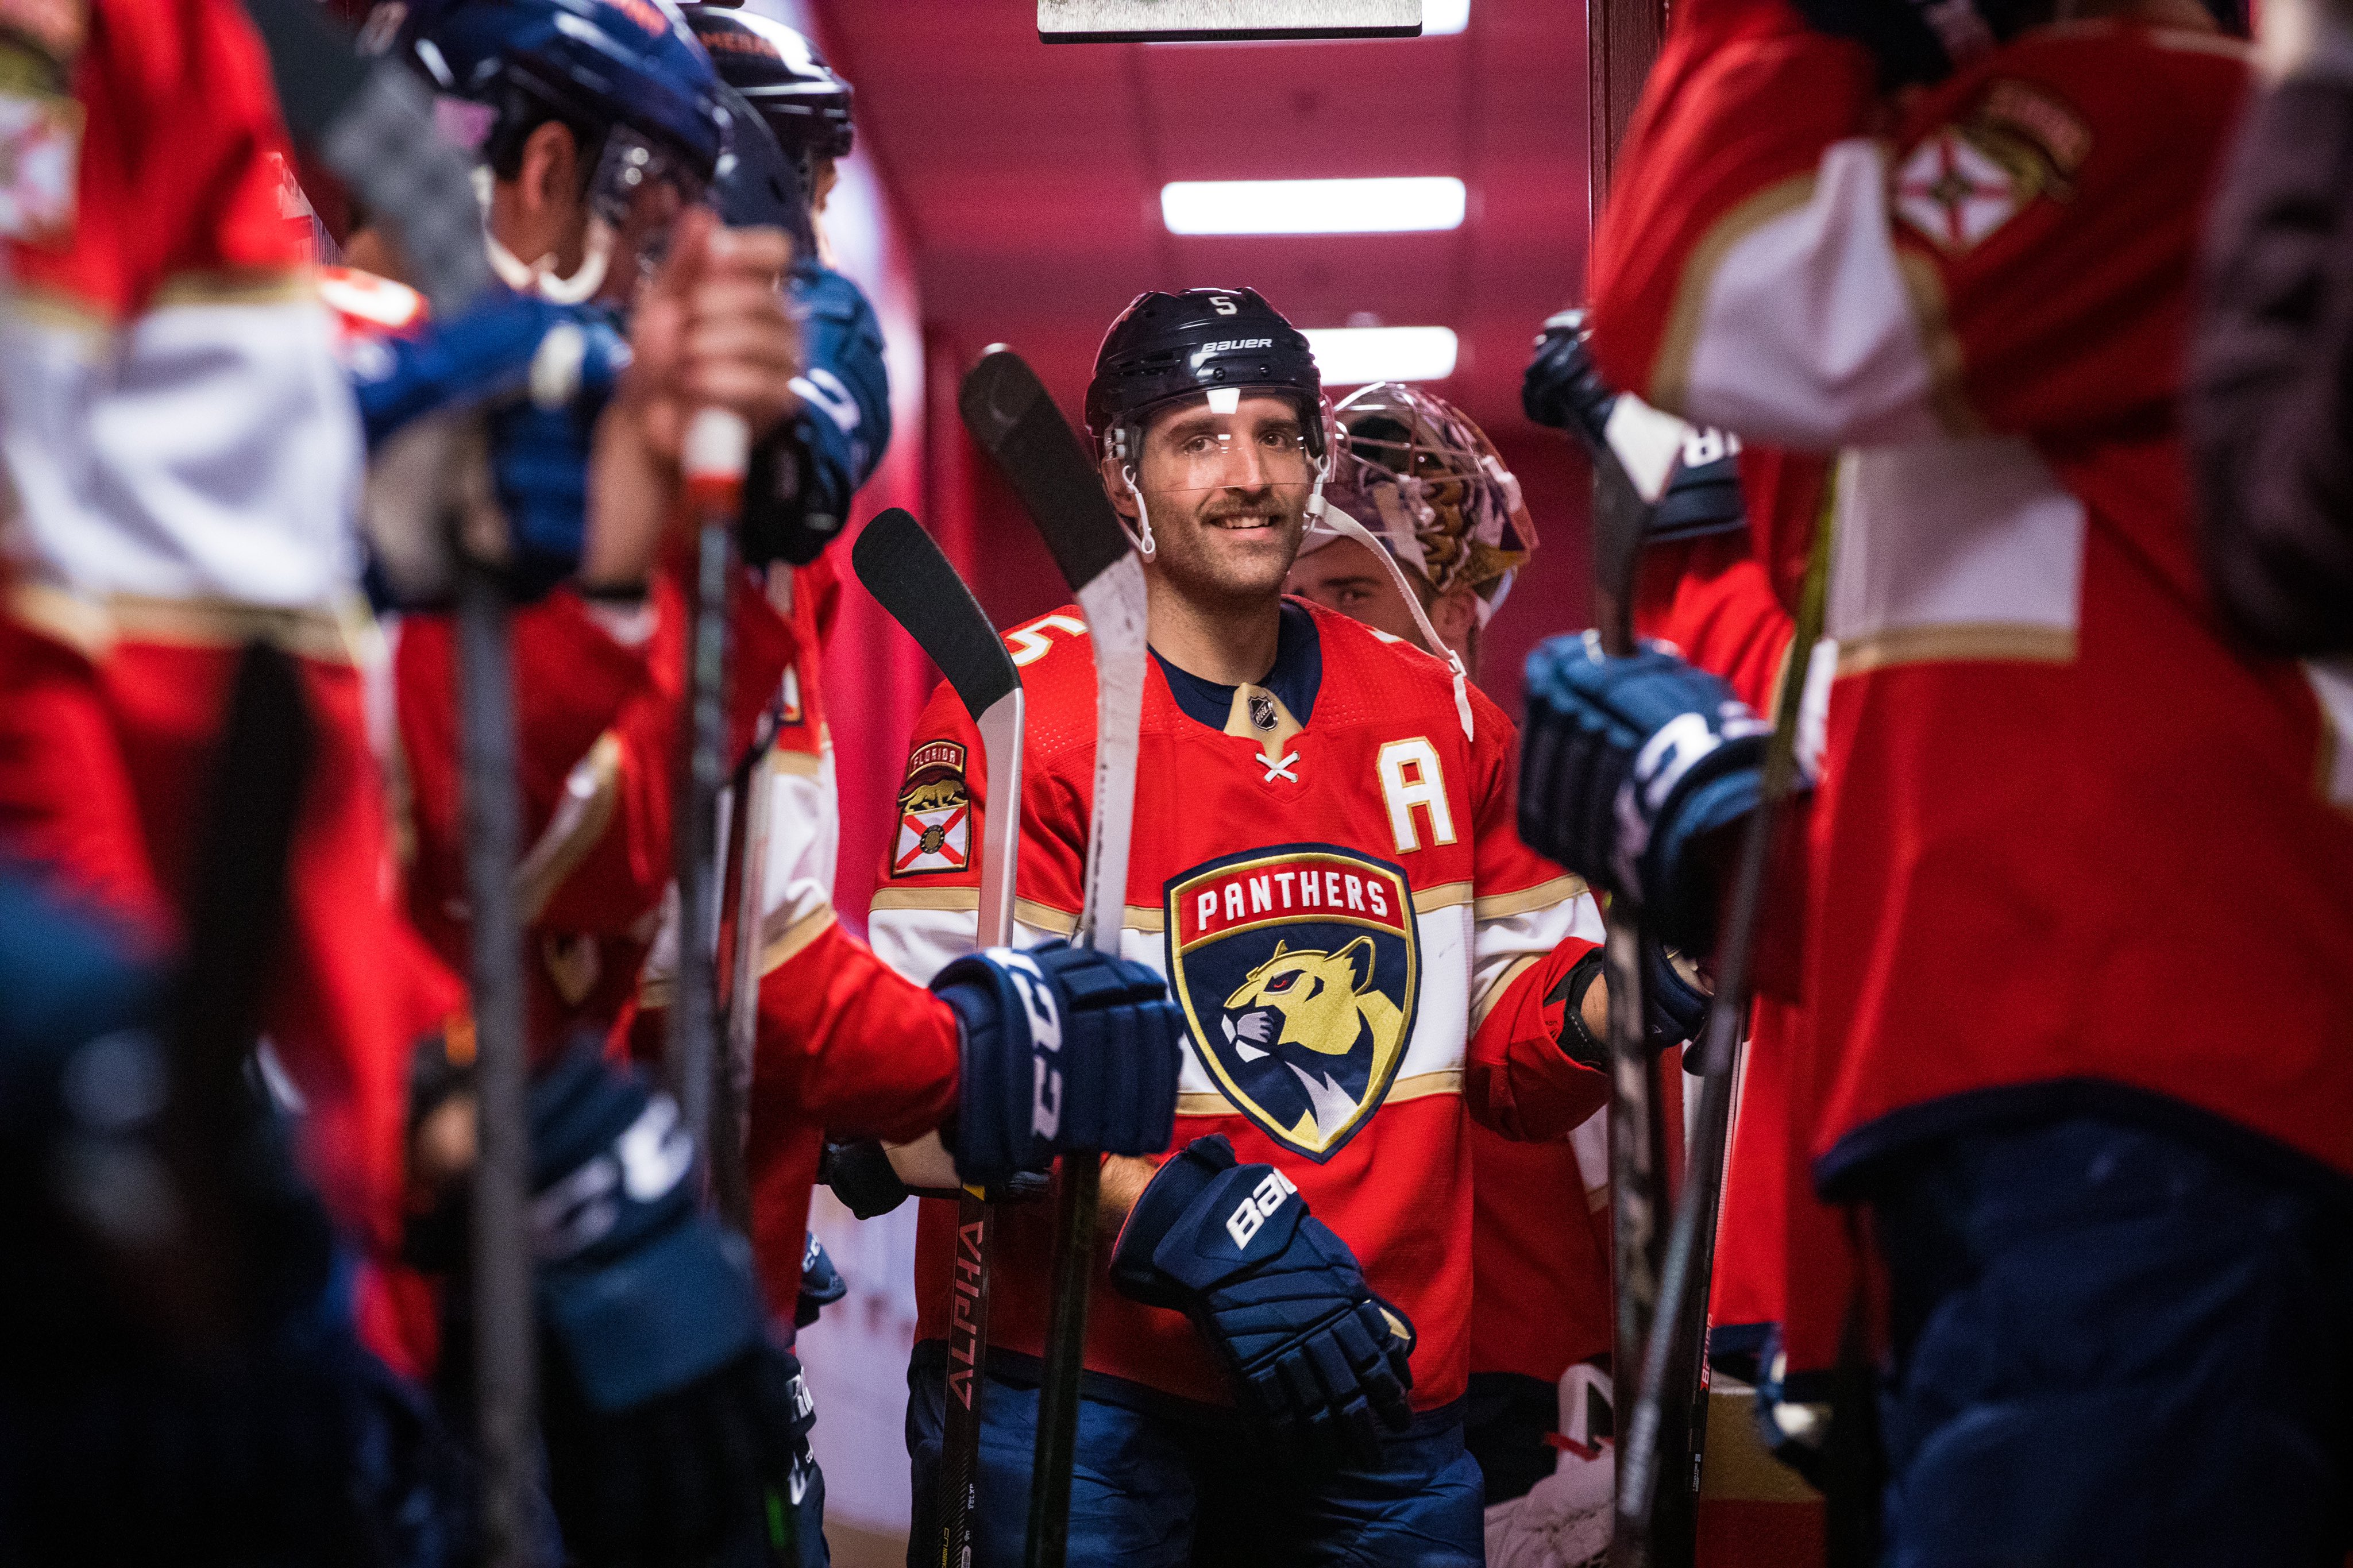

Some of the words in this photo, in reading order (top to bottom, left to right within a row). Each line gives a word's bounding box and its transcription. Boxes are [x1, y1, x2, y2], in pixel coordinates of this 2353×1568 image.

[1209, 296, 1237, 315] 5
[1200, 338, 1272, 353] BAUER
[913, 747, 956, 770] FLORIDA
[1376, 736, 1457, 855] A
[1197, 871, 1388, 931] PANTHERS
[948, 1220, 984, 1412] ALPHA
